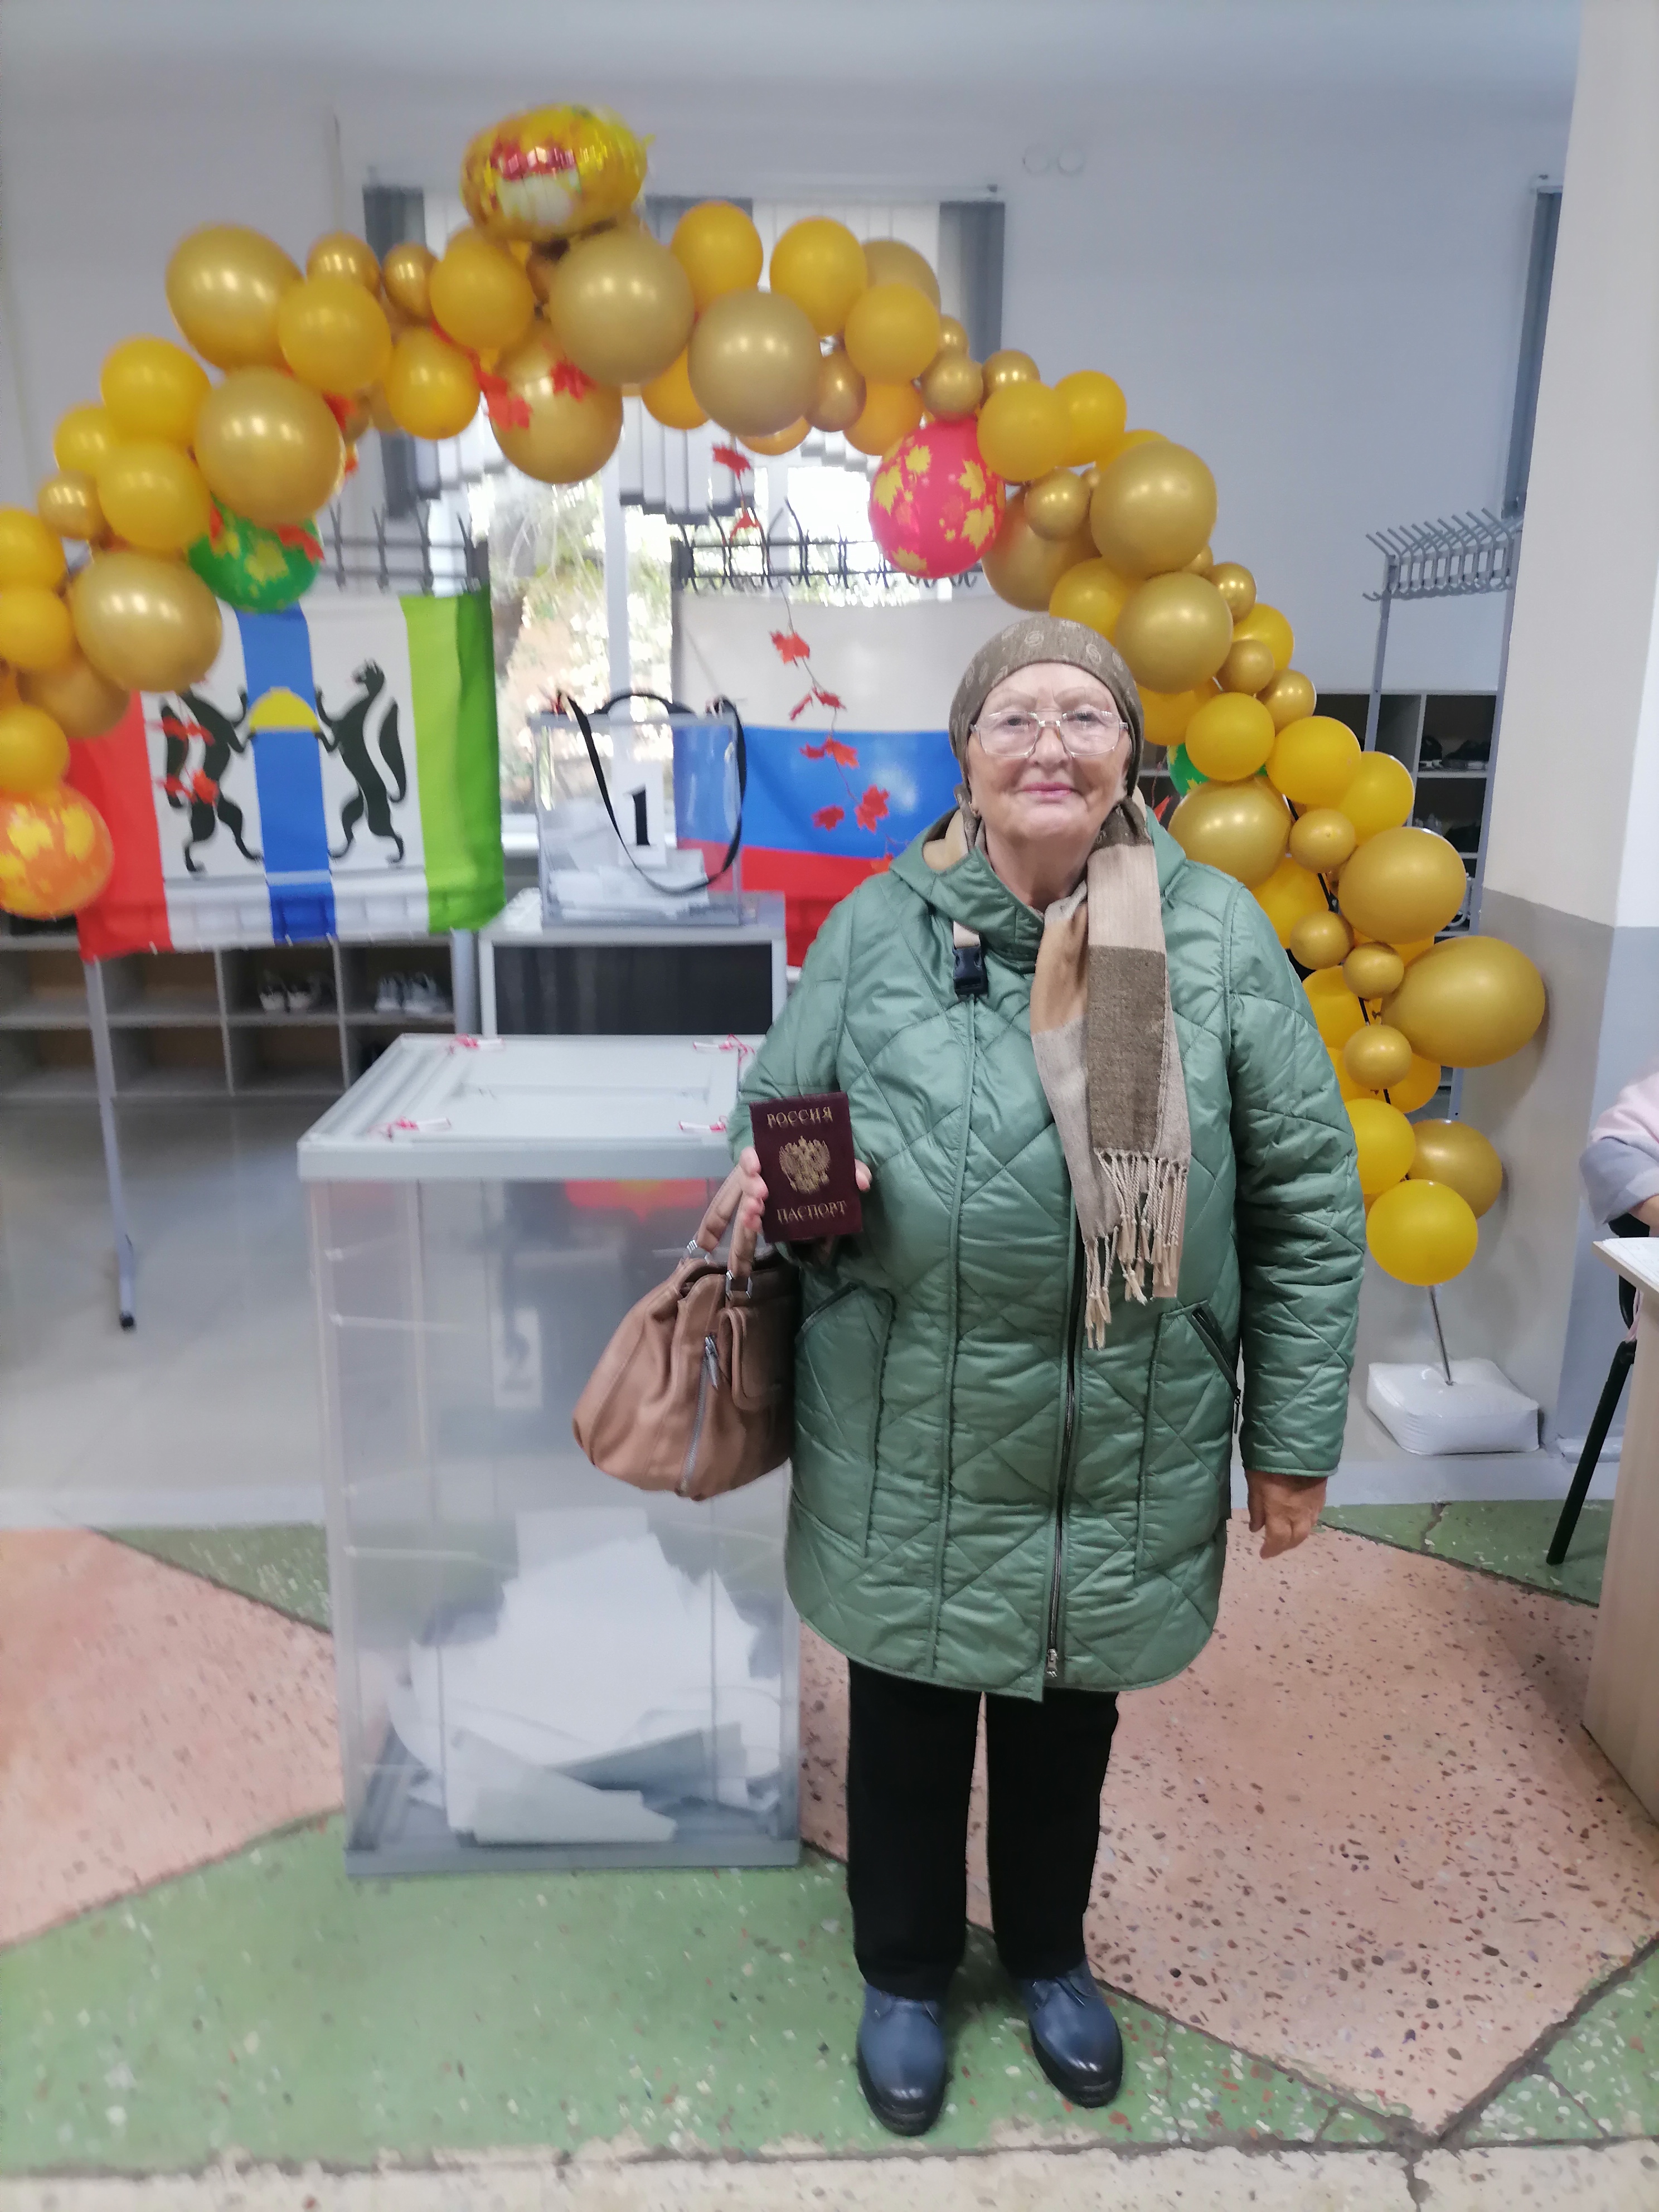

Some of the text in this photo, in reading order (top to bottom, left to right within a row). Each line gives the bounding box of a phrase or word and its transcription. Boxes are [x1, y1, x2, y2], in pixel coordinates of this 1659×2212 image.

[625, 784, 654, 846] 1
[767, 1107, 833, 1128] РОССИЯ
[777, 1200, 847, 1224] ПАСПОРТ
